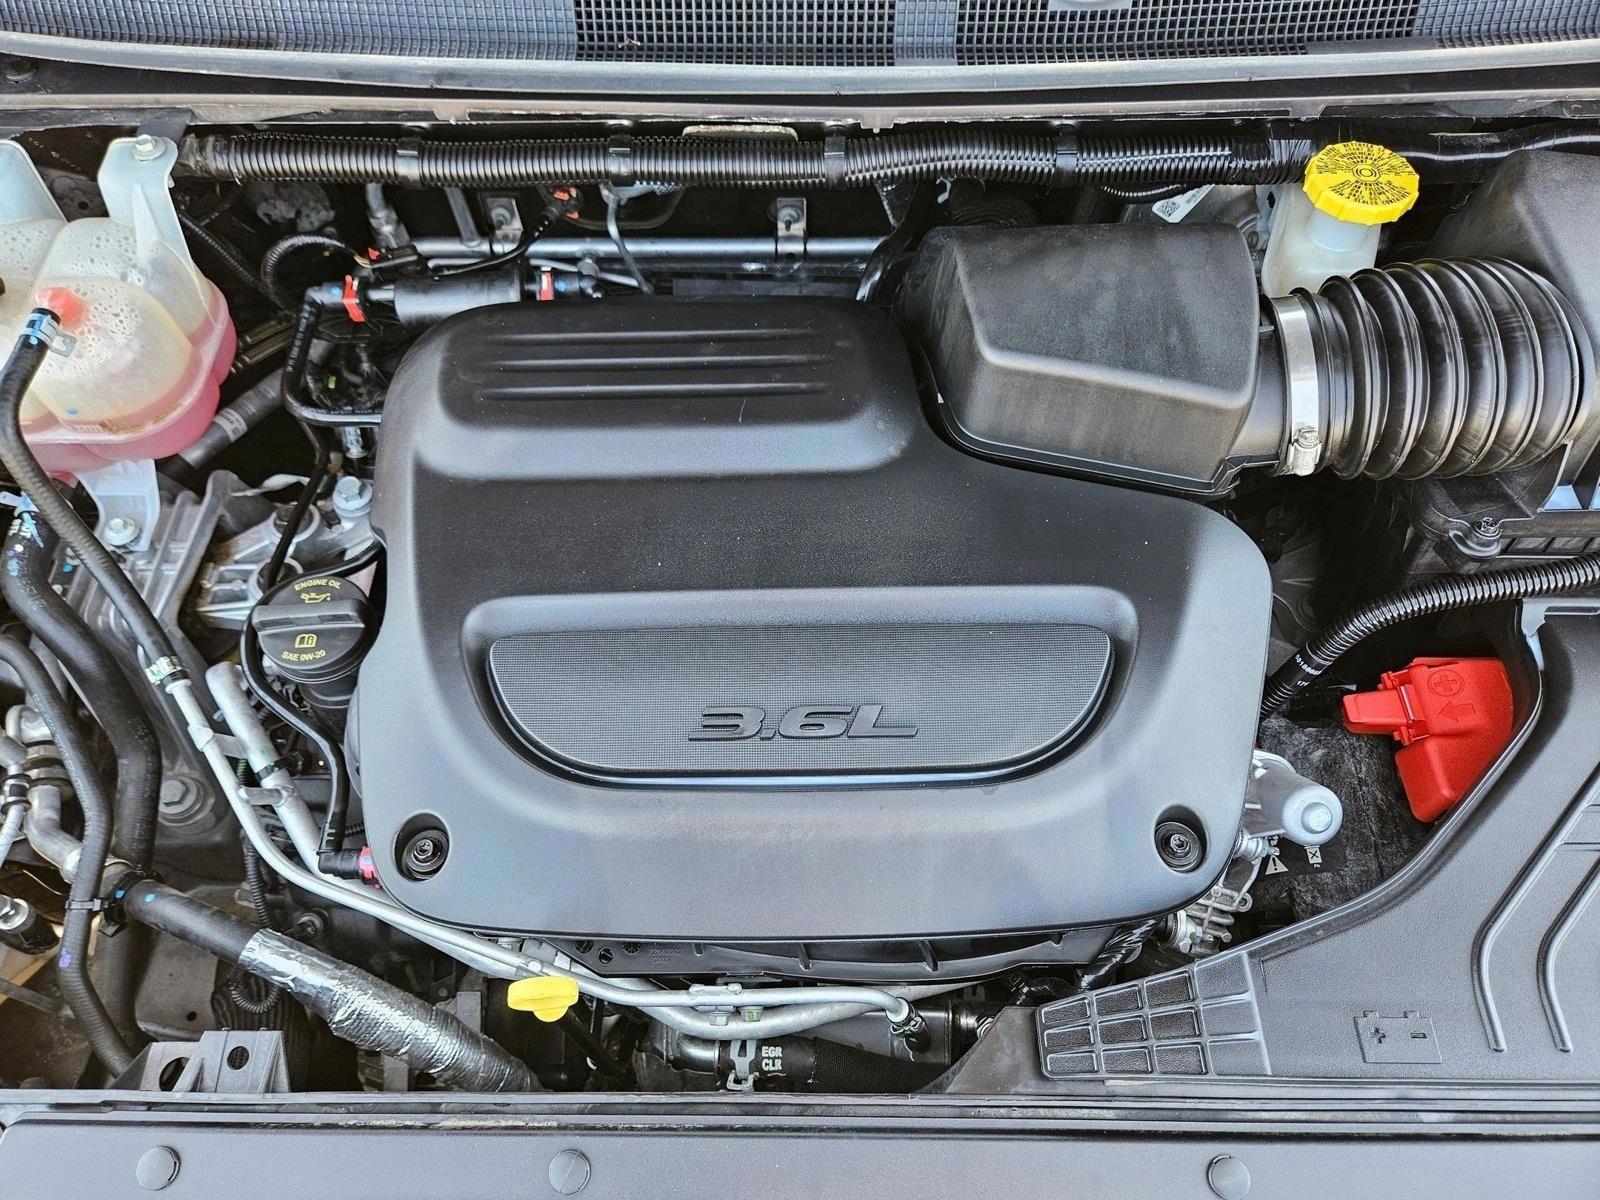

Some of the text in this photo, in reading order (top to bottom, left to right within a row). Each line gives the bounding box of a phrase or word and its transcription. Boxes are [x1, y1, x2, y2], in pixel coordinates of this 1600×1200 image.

[294, 579, 342, 591] ENGINE OIL
[282, 650, 326, 661] SAE 0W-20
[688, 704, 918, 741] 3.6L
[762, 1046, 782, 1057] EGR
[762, 1058, 782, 1070] CLR
